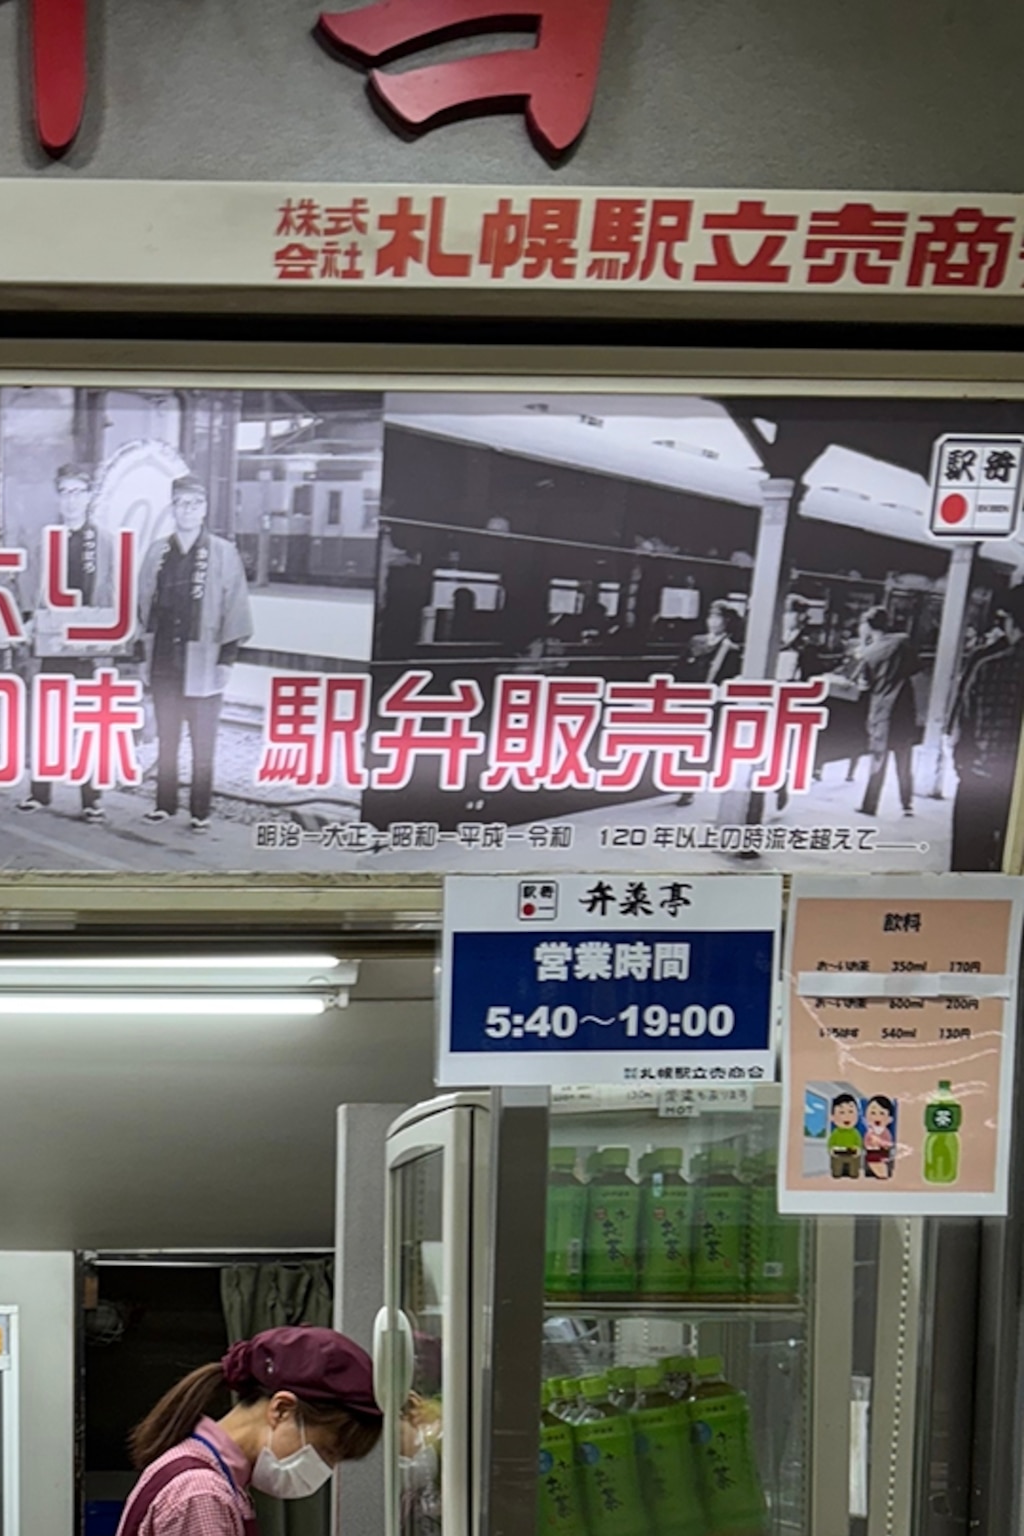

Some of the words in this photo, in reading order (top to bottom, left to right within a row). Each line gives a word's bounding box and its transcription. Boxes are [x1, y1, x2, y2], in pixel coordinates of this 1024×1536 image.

[276, 198, 369, 237] 株式
[376, 196, 1024, 291] 札幌駅立売商
[274, 244, 363, 280] 会社
[256, 671, 830, 793] 駅弁販売所
[579, 881, 695, 917] 弁菜亭
[882, 912, 922, 933] 飲料
[533, 941, 691, 982] 営業時間
[891, 961, 928, 972] 350ml
[949, 961, 981, 973] 170円
[946, 998, 979, 1010] 200円
[881, 1028, 917, 1039] 540ml
[939, 1028, 971, 1040] 130円
[664, 1105, 695, 1115] HOT
[933, 1109, 953, 1127] 茶
